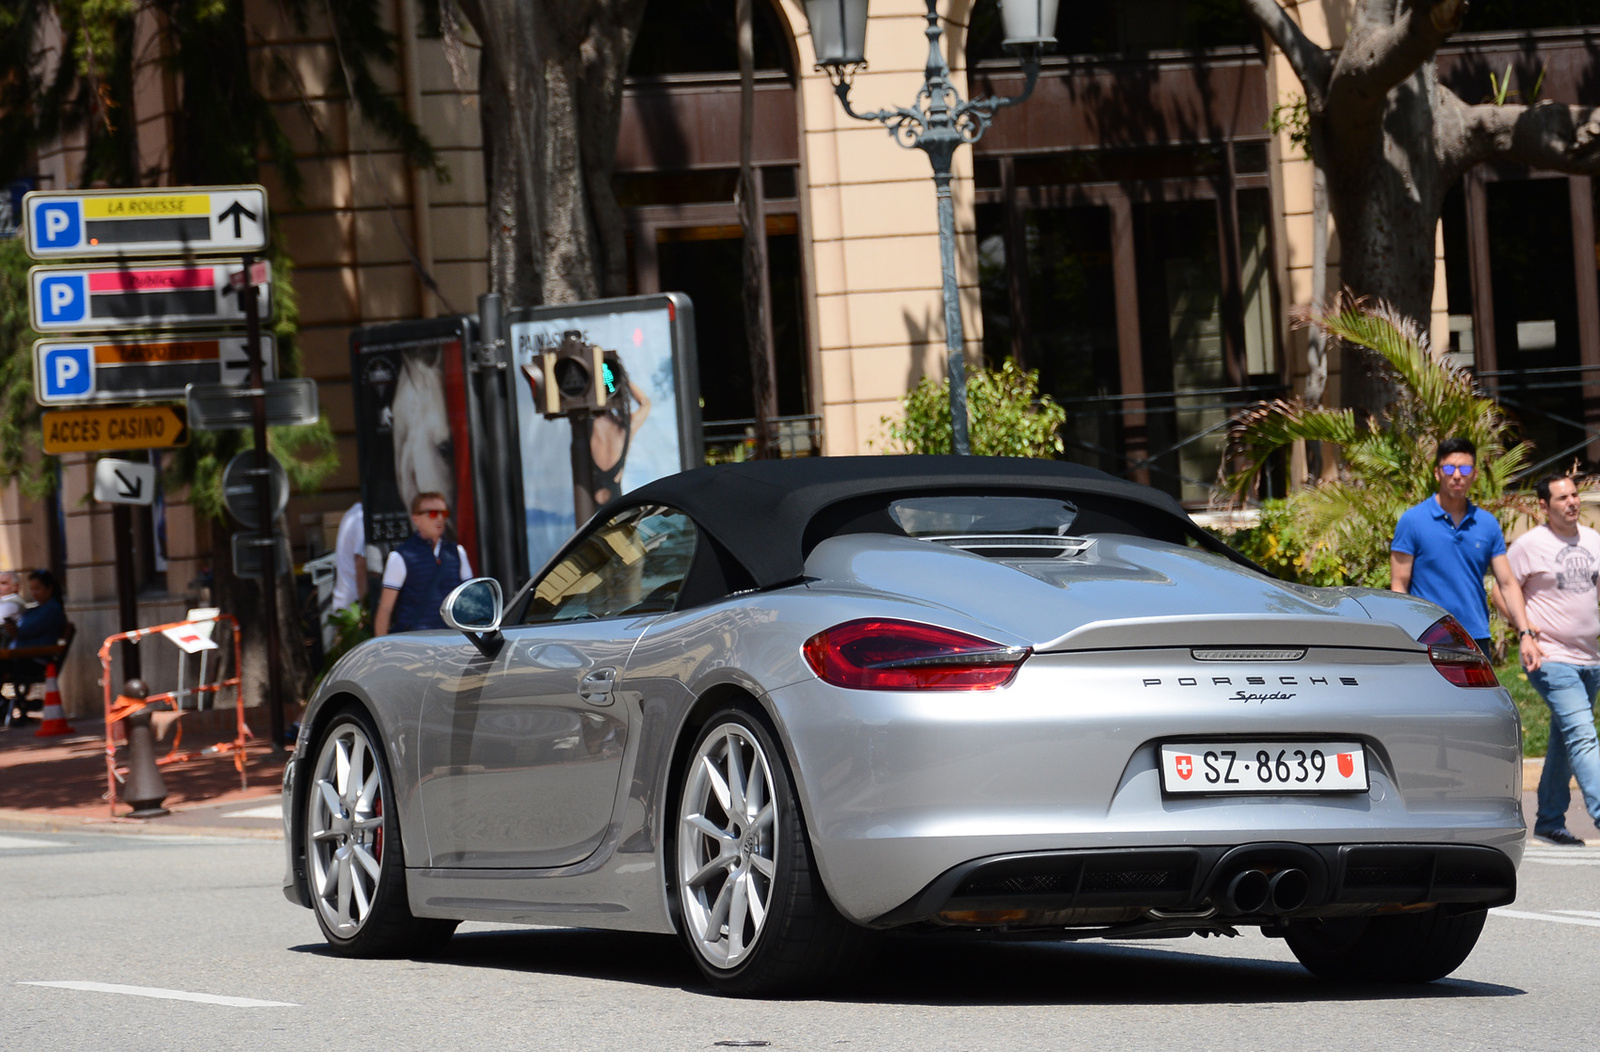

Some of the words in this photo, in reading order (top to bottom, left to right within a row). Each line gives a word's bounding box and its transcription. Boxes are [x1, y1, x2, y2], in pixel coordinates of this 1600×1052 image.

[108, 201, 124, 214] LA
[128, 198, 186, 213] ROUSSE
[45, 208, 70, 241] P
[51, 283, 75, 315] P
[55, 356, 80, 388] P
[49, 416, 100, 443] ACCÈS
[107, 415, 165, 440] CASINO
[1142, 676, 1359, 687] PORSCHE
[1228, 690, 1297, 704] Spyder
